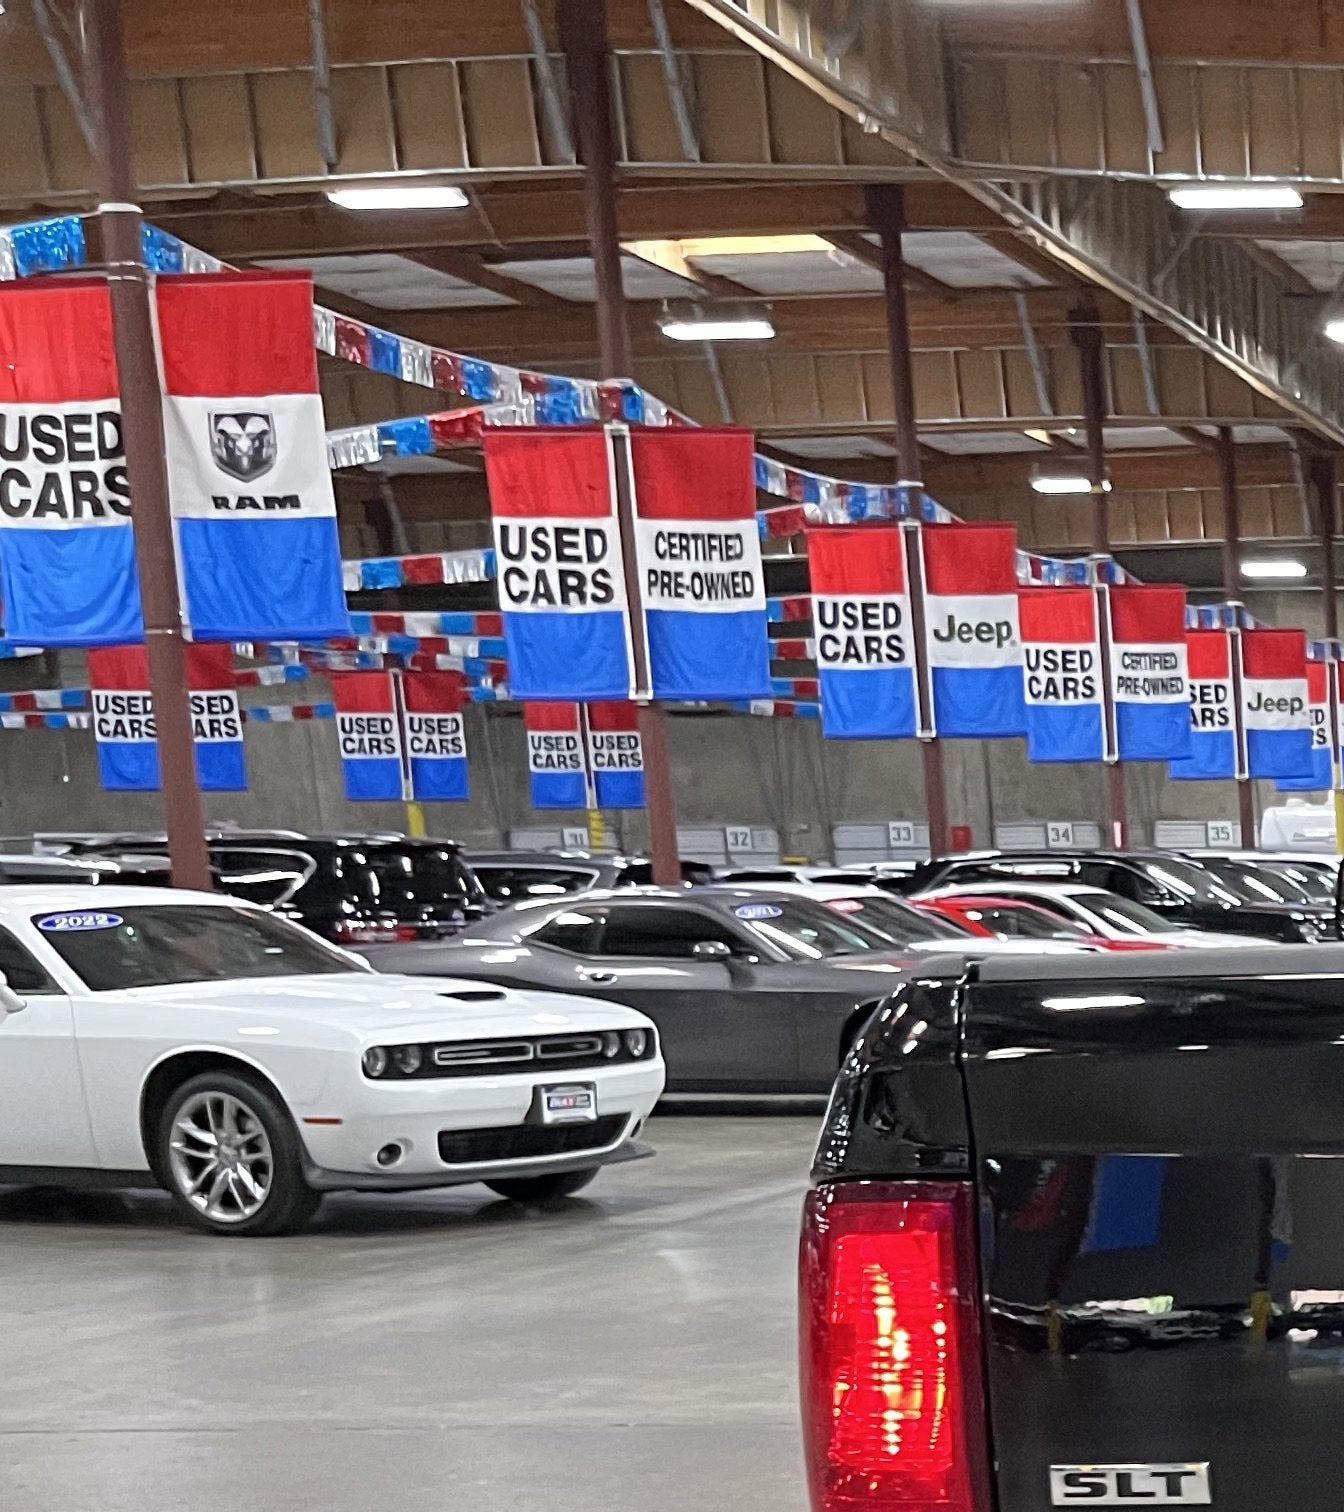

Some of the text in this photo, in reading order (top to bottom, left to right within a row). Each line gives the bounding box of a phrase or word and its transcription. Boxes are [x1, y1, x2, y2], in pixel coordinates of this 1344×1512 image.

[0, 412, 124, 464] USED
[0, 466, 131, 518] CARS
[211, 494, 301, 510] RAM
[500, 525, 607, 563] USED
[655, 531, 743, 561] CERTIFIED
[503, 567, 614, 606] CARS
[648, 569, 754, 600] PRE-OWNED
[818, 601, 901, 630] USED
[933, 614, 1013, 648] Jeep
[819, 634, 905, 663] CARS
[1025, 649, 1093, 673] USED
[1028, 676, 1096, 700] CARS
[1117, 676, 1184, 696] PRE-OWNED
[190, 695, 234, 715] SED
[1248, 692, 1304, 716] Jeep
[98, 718, 157, 738] CARS
[194, 718, 238, 738] ARS
[341, 717, 393, 735] USED
[409, 717, 460, 735] USED
[342, 737, 396, 755] CARS
[410, 736, 463, 754] CARS
[530, 735, 578, 751] USED
[593, 735, 639, 750] USED
[532, 753, 581, 769] CARS
[594, 752, 642, 768] CARS
[729, 831, 749, 846] 32
[892, 827, 911, 841] 33
[1050, 828, 1070, 842] 34
[1210, 826, 1230, 840] 35
[54, 914, 109, 929] 2022
[1063, 1471, 1196, 1498] SLT
